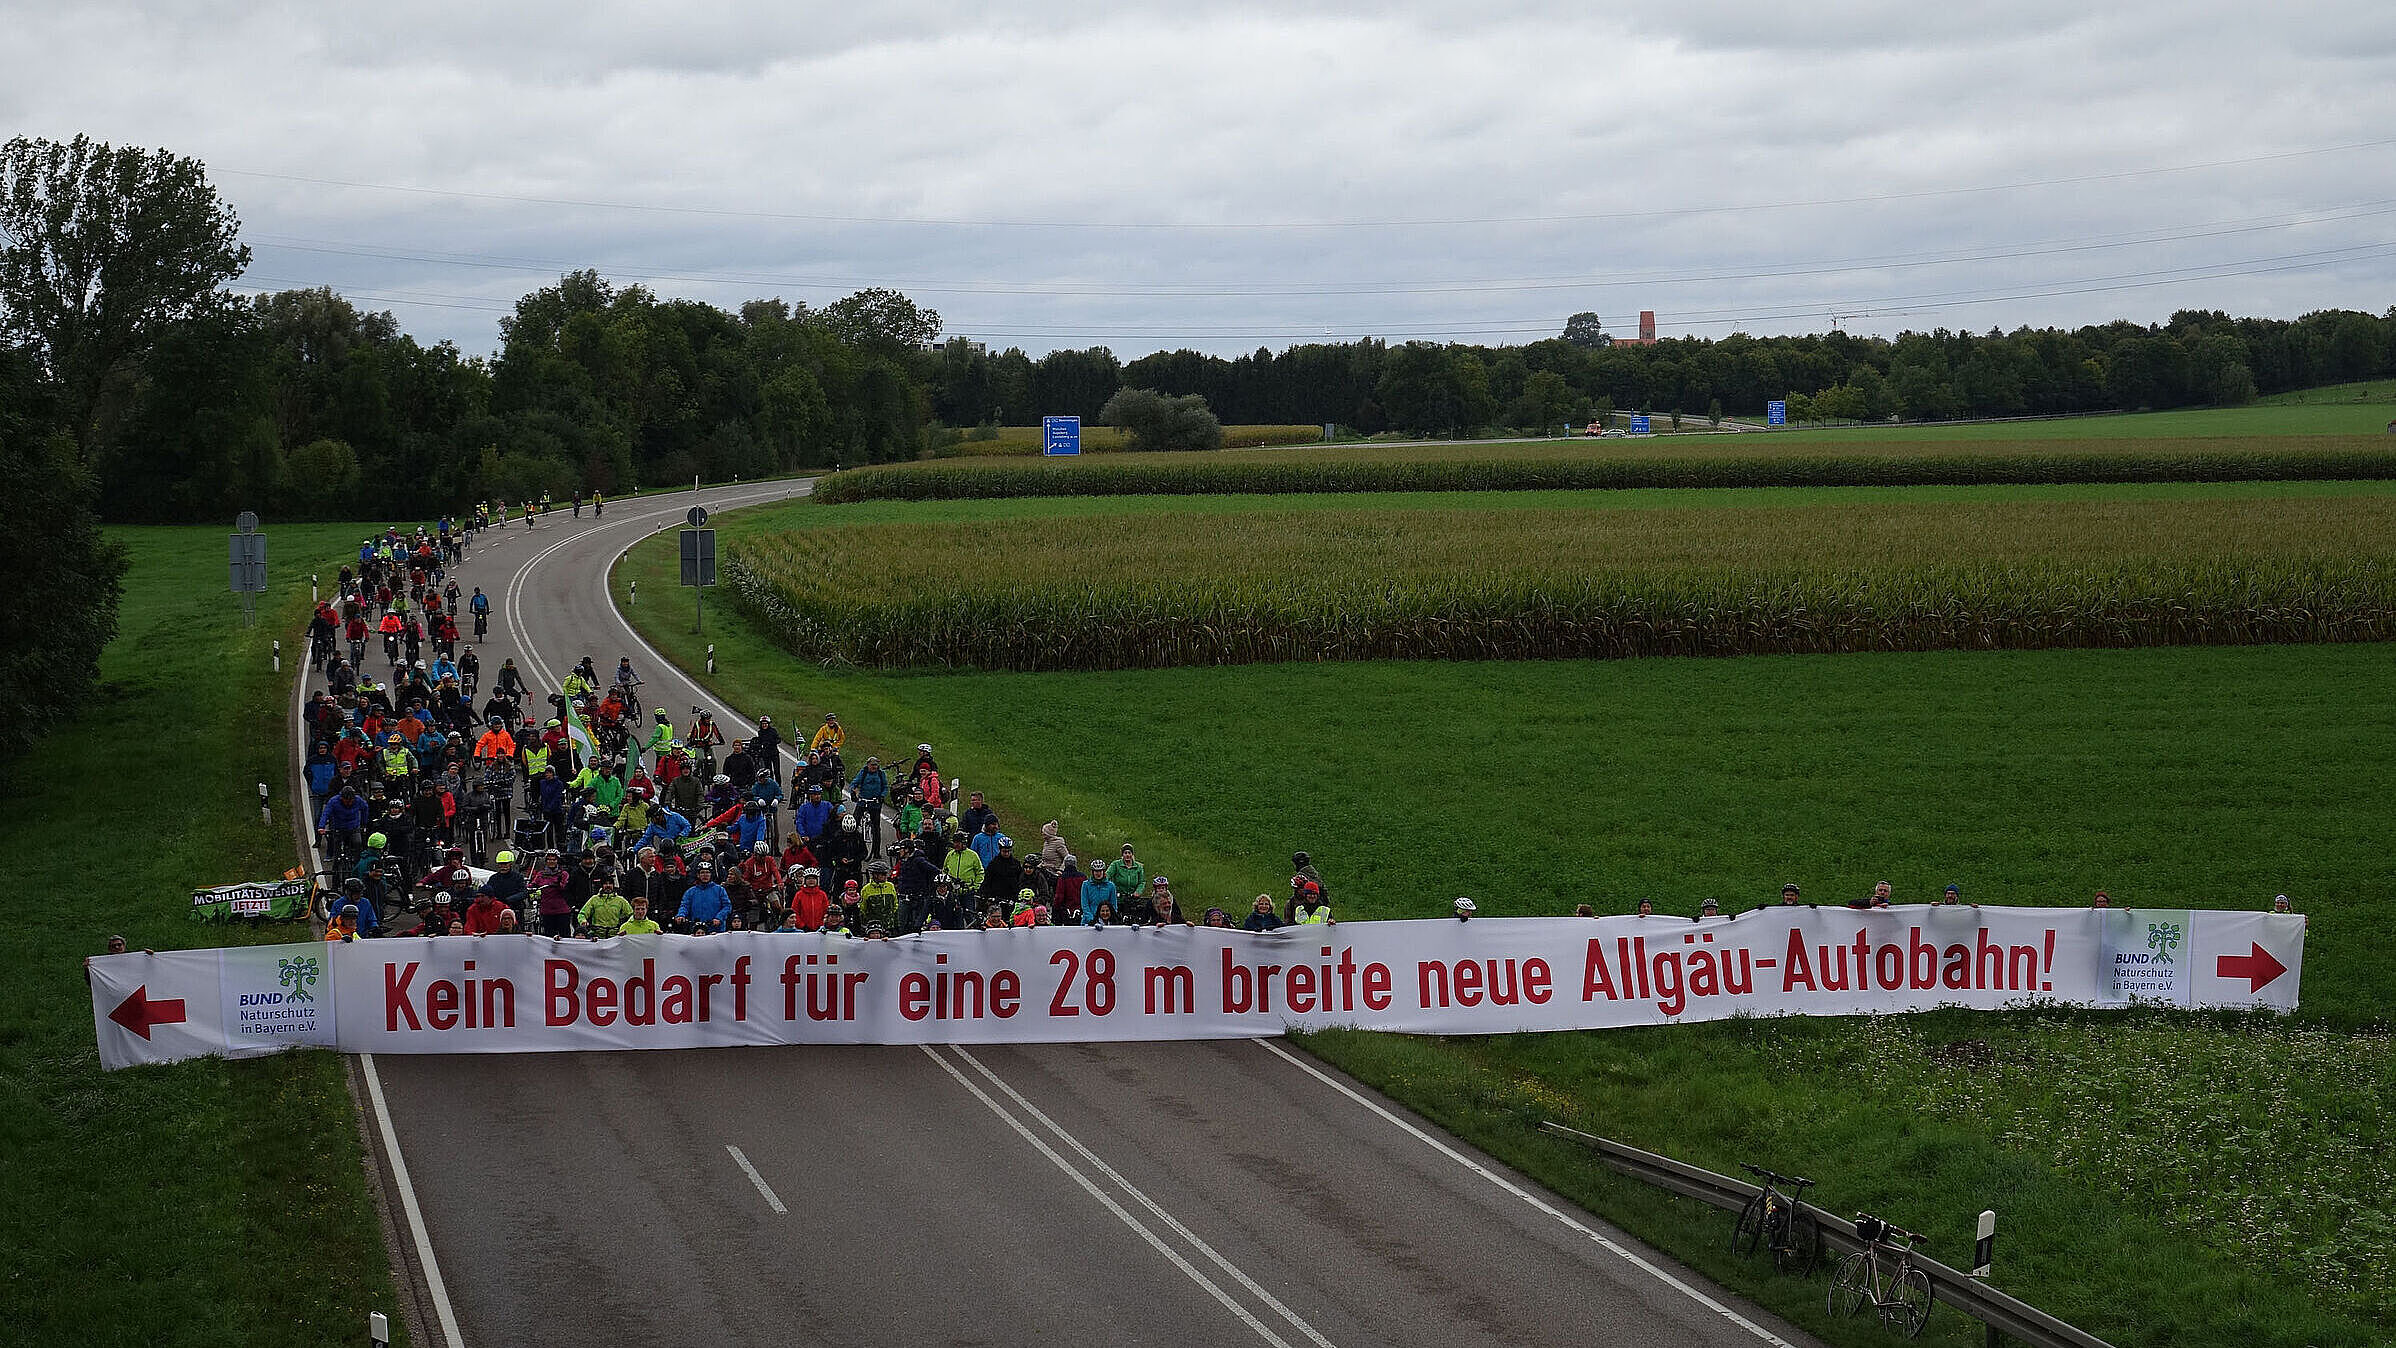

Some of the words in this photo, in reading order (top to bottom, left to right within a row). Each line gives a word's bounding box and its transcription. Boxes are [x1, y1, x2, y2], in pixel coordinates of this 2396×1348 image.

[194, 884, 306, 905] MOBILITÄTSWENDE
[232, 900, 268, 912] JETZT!
[2115, 953, 2149, 964] BUND
[383, 961, 514, 1031] Kein
[544, 956, 751, 1027] Bedarf
[781, 955, 867, 1021] für
[899, 954, 1021, 1021] eine
[1049, 949, 1115, 1017] 28
[1144, 966, 1193, 1015] m
[1222, 946, 1393, 1014] breite
[1417, 957, 1553, 1009] neue
[1582, 927, 2056, 1016] Allgäu-Autobahn!
[2114, 967, 2174, 978] Naturschutz
[2112, 979, 2122, 990] in
[2123, 980, 2156, 992] Bayern
[2158, 981, 2173, 991] e.V.
[239, 993, 283, 1006] BUND
[240, 1007, 316, 1021] Naturschutz
[240, 1024, 252, 1034] in
[254, 1023, 296, 1035] Bayern
[298, 1021, 316, 1032] e.V.
